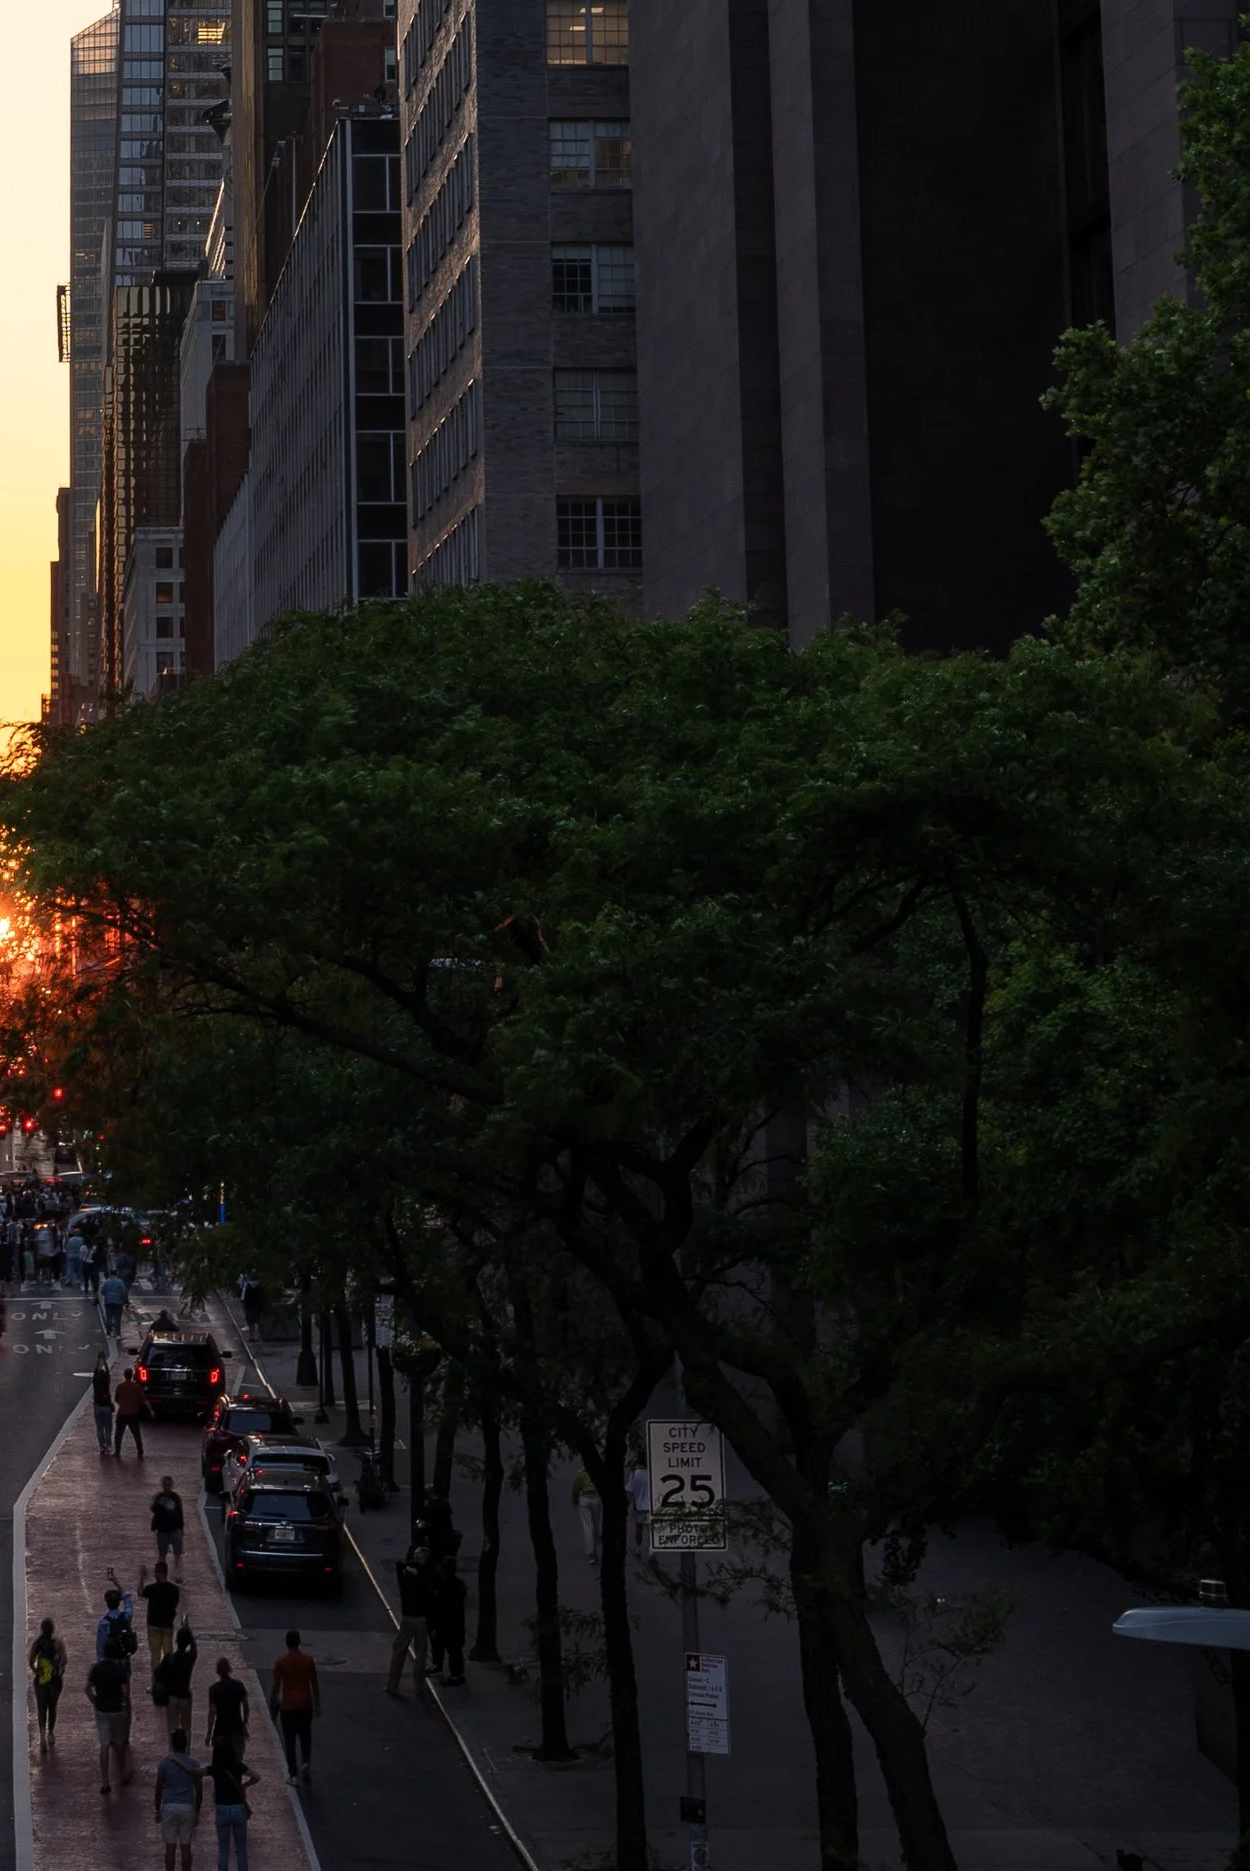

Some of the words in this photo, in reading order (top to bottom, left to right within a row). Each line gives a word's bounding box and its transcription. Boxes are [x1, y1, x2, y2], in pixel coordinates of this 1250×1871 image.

[668, 1426, 699, 1438] CITY
[662, 1441, 707, 1453] SPEED
[667, 1456, 703, 1469] LIMIT
[660, 1473, 716, 1509] 25
